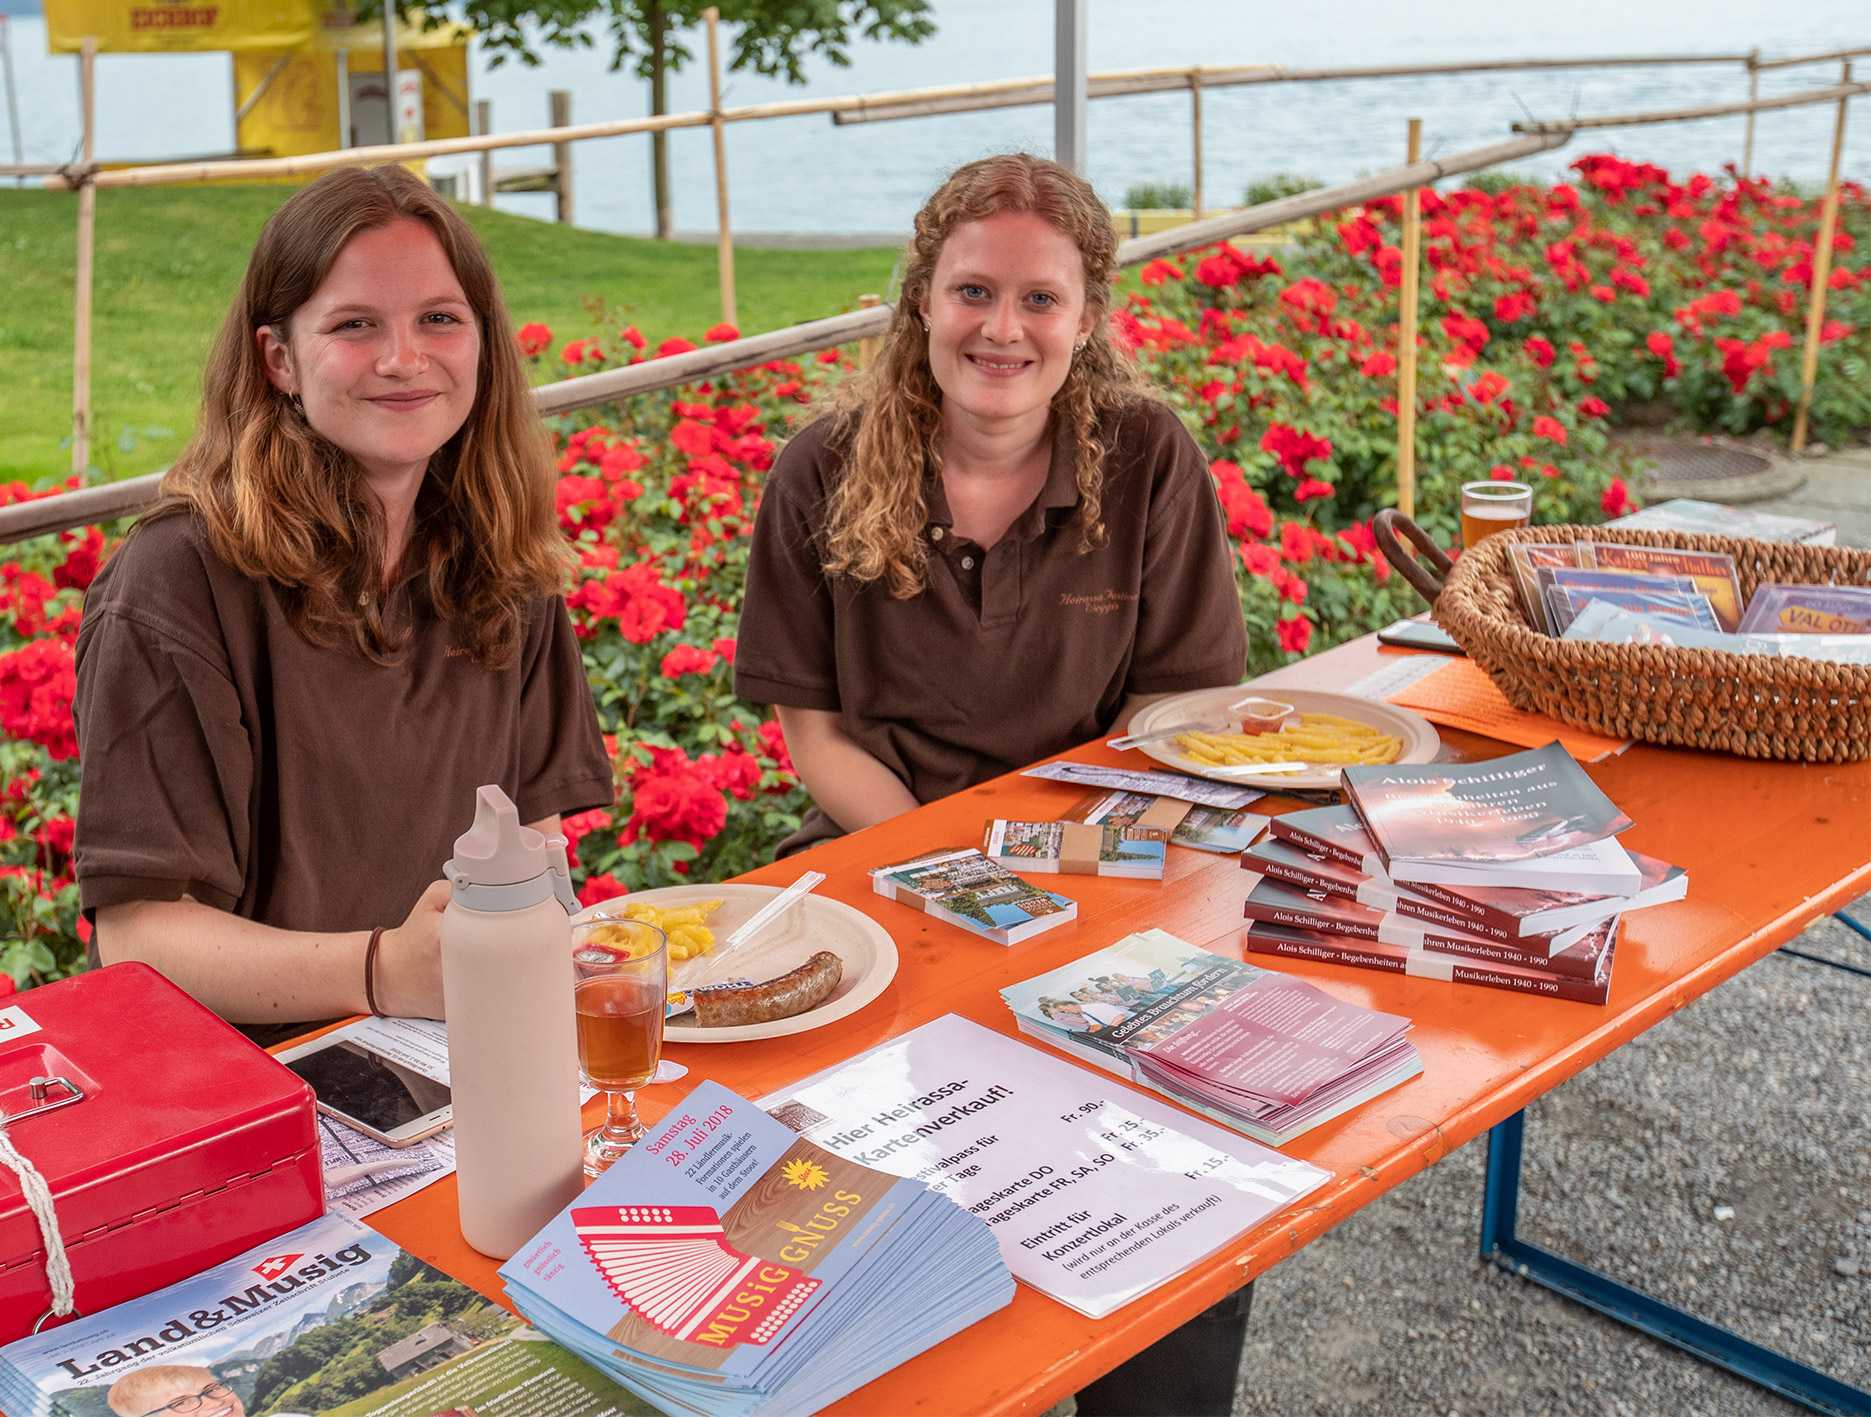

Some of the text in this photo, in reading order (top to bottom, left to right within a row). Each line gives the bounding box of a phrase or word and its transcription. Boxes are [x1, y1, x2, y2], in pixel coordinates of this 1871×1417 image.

[1649, 553, 1680, 564] Jahre
[1382, 763, 1547, 785] Alois Schilliger
[1527, 780, 1558, 793] aus
[1500, 812, 1540, 824] 1990
[1290, 832, 1304, 843] Alois
[1304, 836, 1329, 853] Schilliger
[1333, 846, 1362, 866] Begebenhe
[1266, 864, 1282, 875] Alois
[1284, 869, 1314, 884] Schilliger
[1320, 879, 1357, 896] Begebenhe
[1411, 881, 1450, 901] Musikerleben
[1452, 898, 1465, 908] 1940
[1471, 904, 1485, 916] 1990
[1274, 912, 1293, 922] Alois
[1295, 913, 1330, 928] Schilliger
[1417, 906, 1470, 926] Musikerleben
[1467, 921, 1484, 932] 1940
[1490, 927, 1507, 938] 1990
[1277, 943, 1297, 952] Alois
[1299, 945, 1335, 959] Schilliger
[1342, 953, 1398, 967] Begebenheiten
[1447, 939, 1500, 957] Musikerleben
[1503, 952, 1522, 961] 1940
[1529, 956, 1548, 966] 1990
[1455, 969, 1558, 992] Musikerleben 1940 1990
[1112, 966, 1228, 1038] Gelebtes Brauchtum fördern
[1162, 1043, 1176, 1054] Die
[822, 1122, 875, 1151] Hier
[871, 1079, 969, 1127] Heirassa-
[853, 1084, 1014, 1166] Kartenverkauf!
[1061, 1099, 1105, 1124] Fr. 90.-
[646, 1114, 697, 1155] Samstag
[665, 1104, 733, 1167] 28. Juli 2018
[1100, 1118, 1145, 1142] Fr. 25.-
[1121, 1127, 1165, 1152] Fr. 35.-
[685, 1132, 733, 1178] 22 Ländlermusik-
[696, 1131, 752, 1185] Formationen spielen
[706, 1144, 757, 1193] in 10 Gasthäusern
[910, 1134, 999, 1182] estivalpass für
[1049, 1177, 1077, 1191] FR,
[1071, 1164, 1099, 1178] SA,
[1093, 1153, 1115, 1168] SO
[1184, 1154, 1230, 1180] Fr. 15.-
[719, 1159, 760, 1199] auf dem Stoos!
[928, 1163, 982, 1193] er Tage
[964, 1165, 1054, 1214] ageskarte DO
[780, 1188, 862, 1262] GNUSS
[1020, 1210, 1092, 1250] Eintritt für
[1042, 1213, 1128, 1262] Konzertlokal
[1062, 1202, 1180, 1272] (wird nur an der Kasse des
[1080, 1194, 1223, 1280] entsprechenden Lokals verkauft)
[56, 1242, 372, 1381] Land&Musig
[77, 1267, 350, 1386] 22. Jahrgang der volkstümlichen Schweizer Zeitschrift Stubete
[446, 1367, 458, 1376] die
